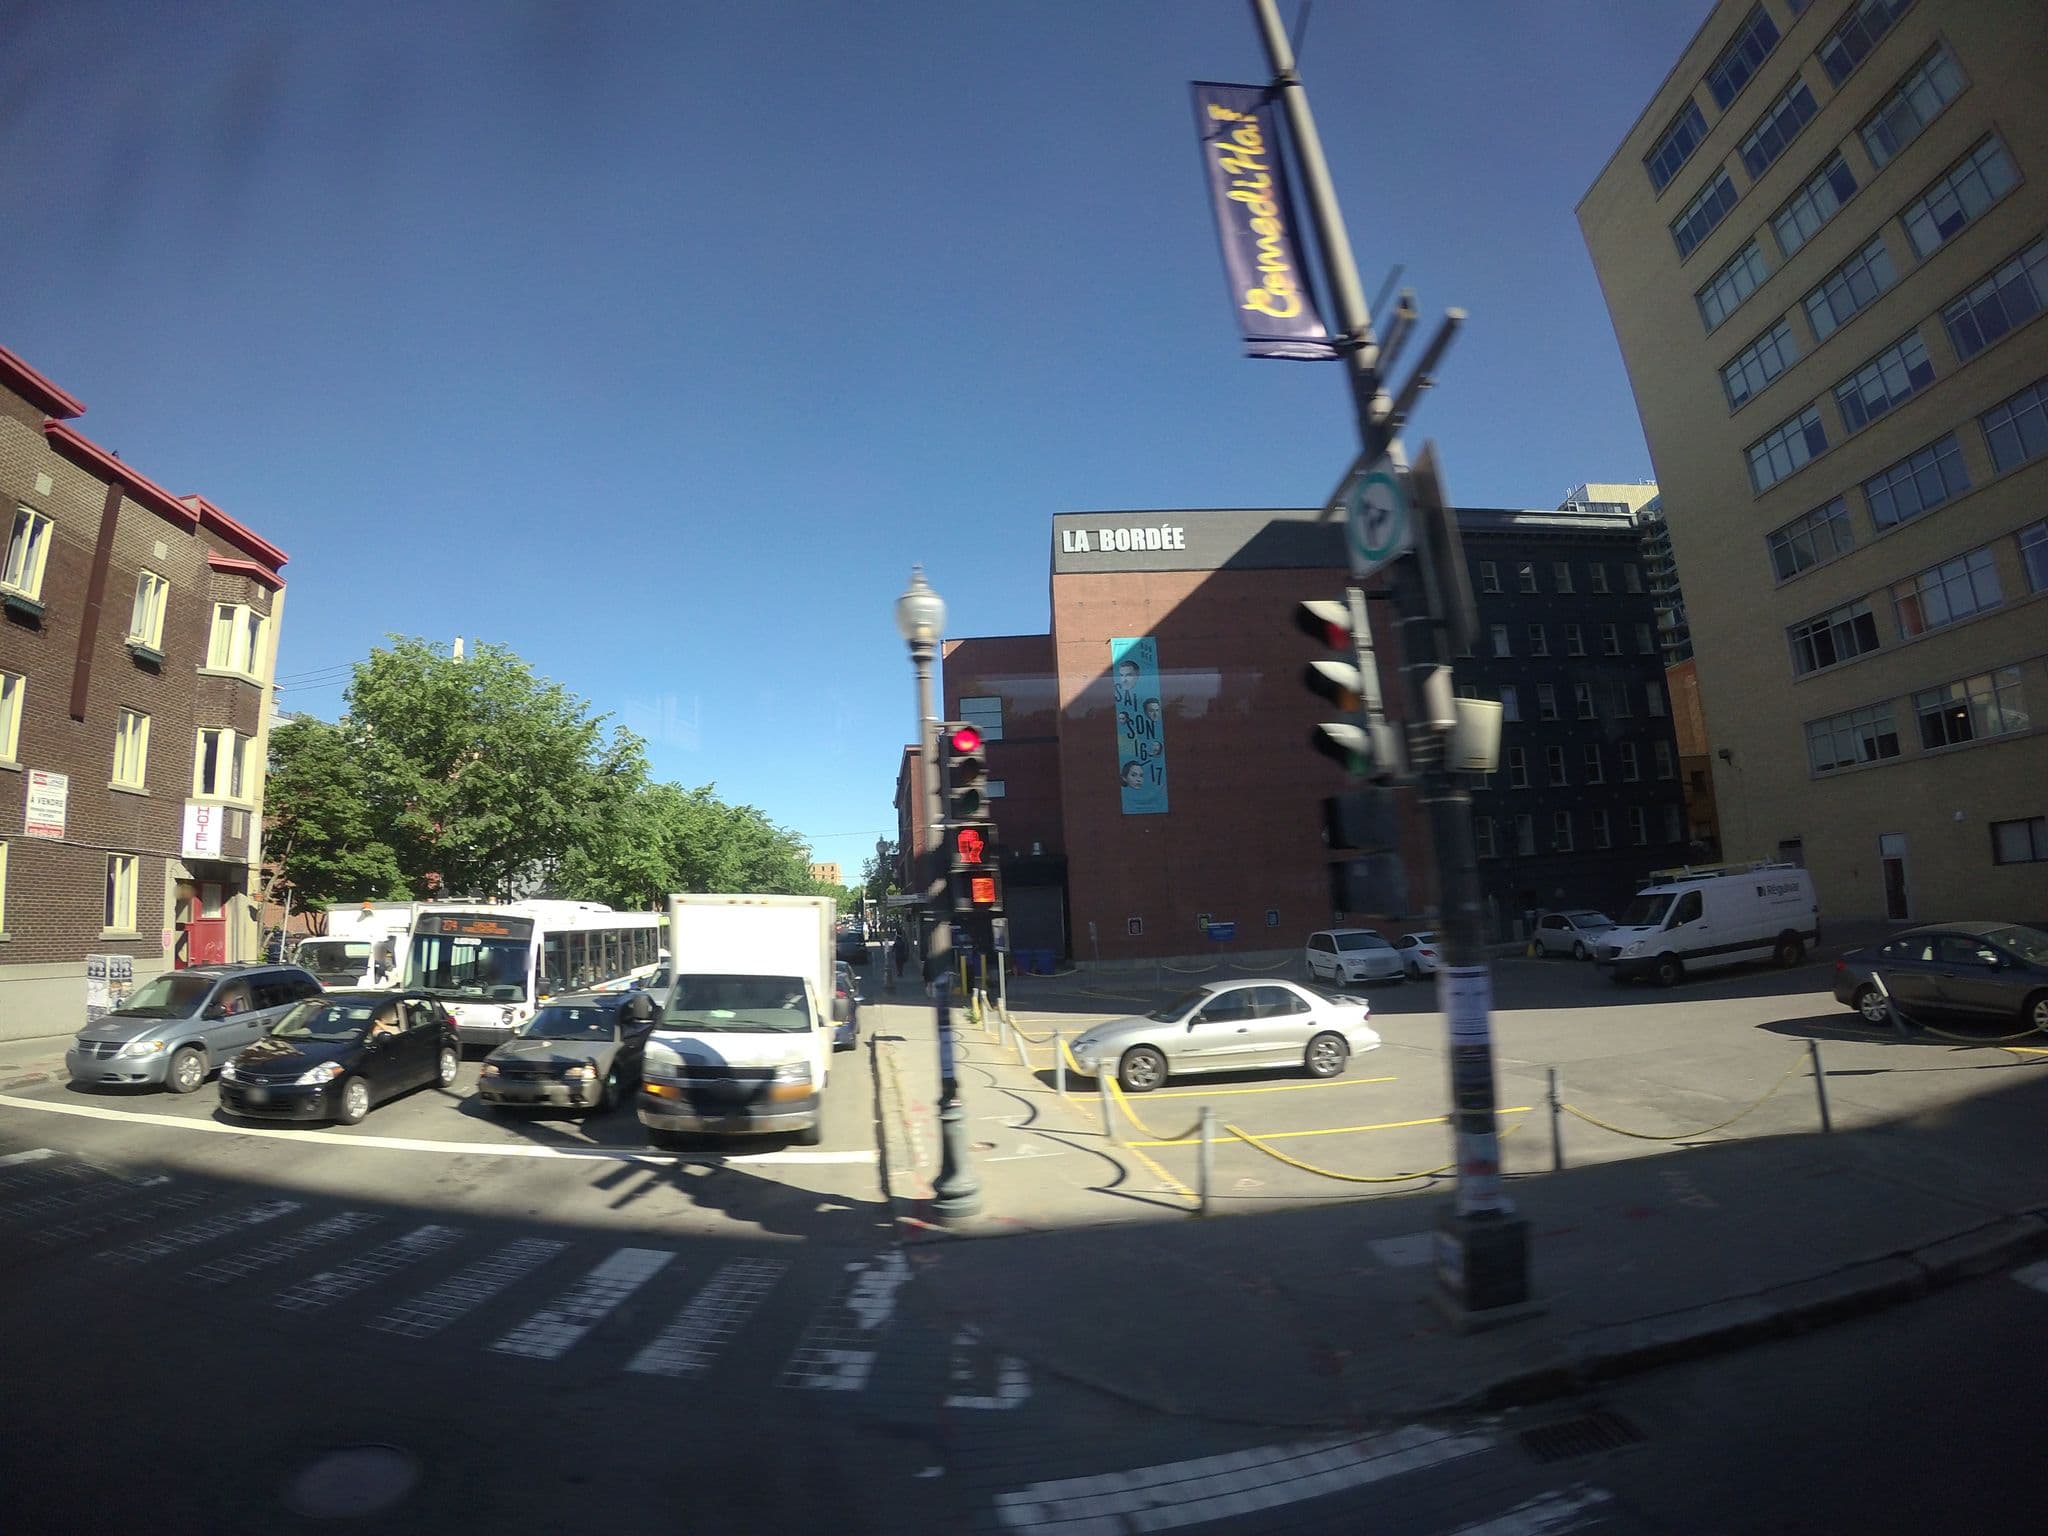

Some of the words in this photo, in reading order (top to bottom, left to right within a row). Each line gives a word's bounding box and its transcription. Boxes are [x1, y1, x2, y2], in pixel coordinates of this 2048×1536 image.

[1062, 529, 1091, 553] LA
[1099, 523, 1186, 552] BORDÉE
[1114, 683, 1138, 712] SAI
[1126, 714, 1156, 740] SON
